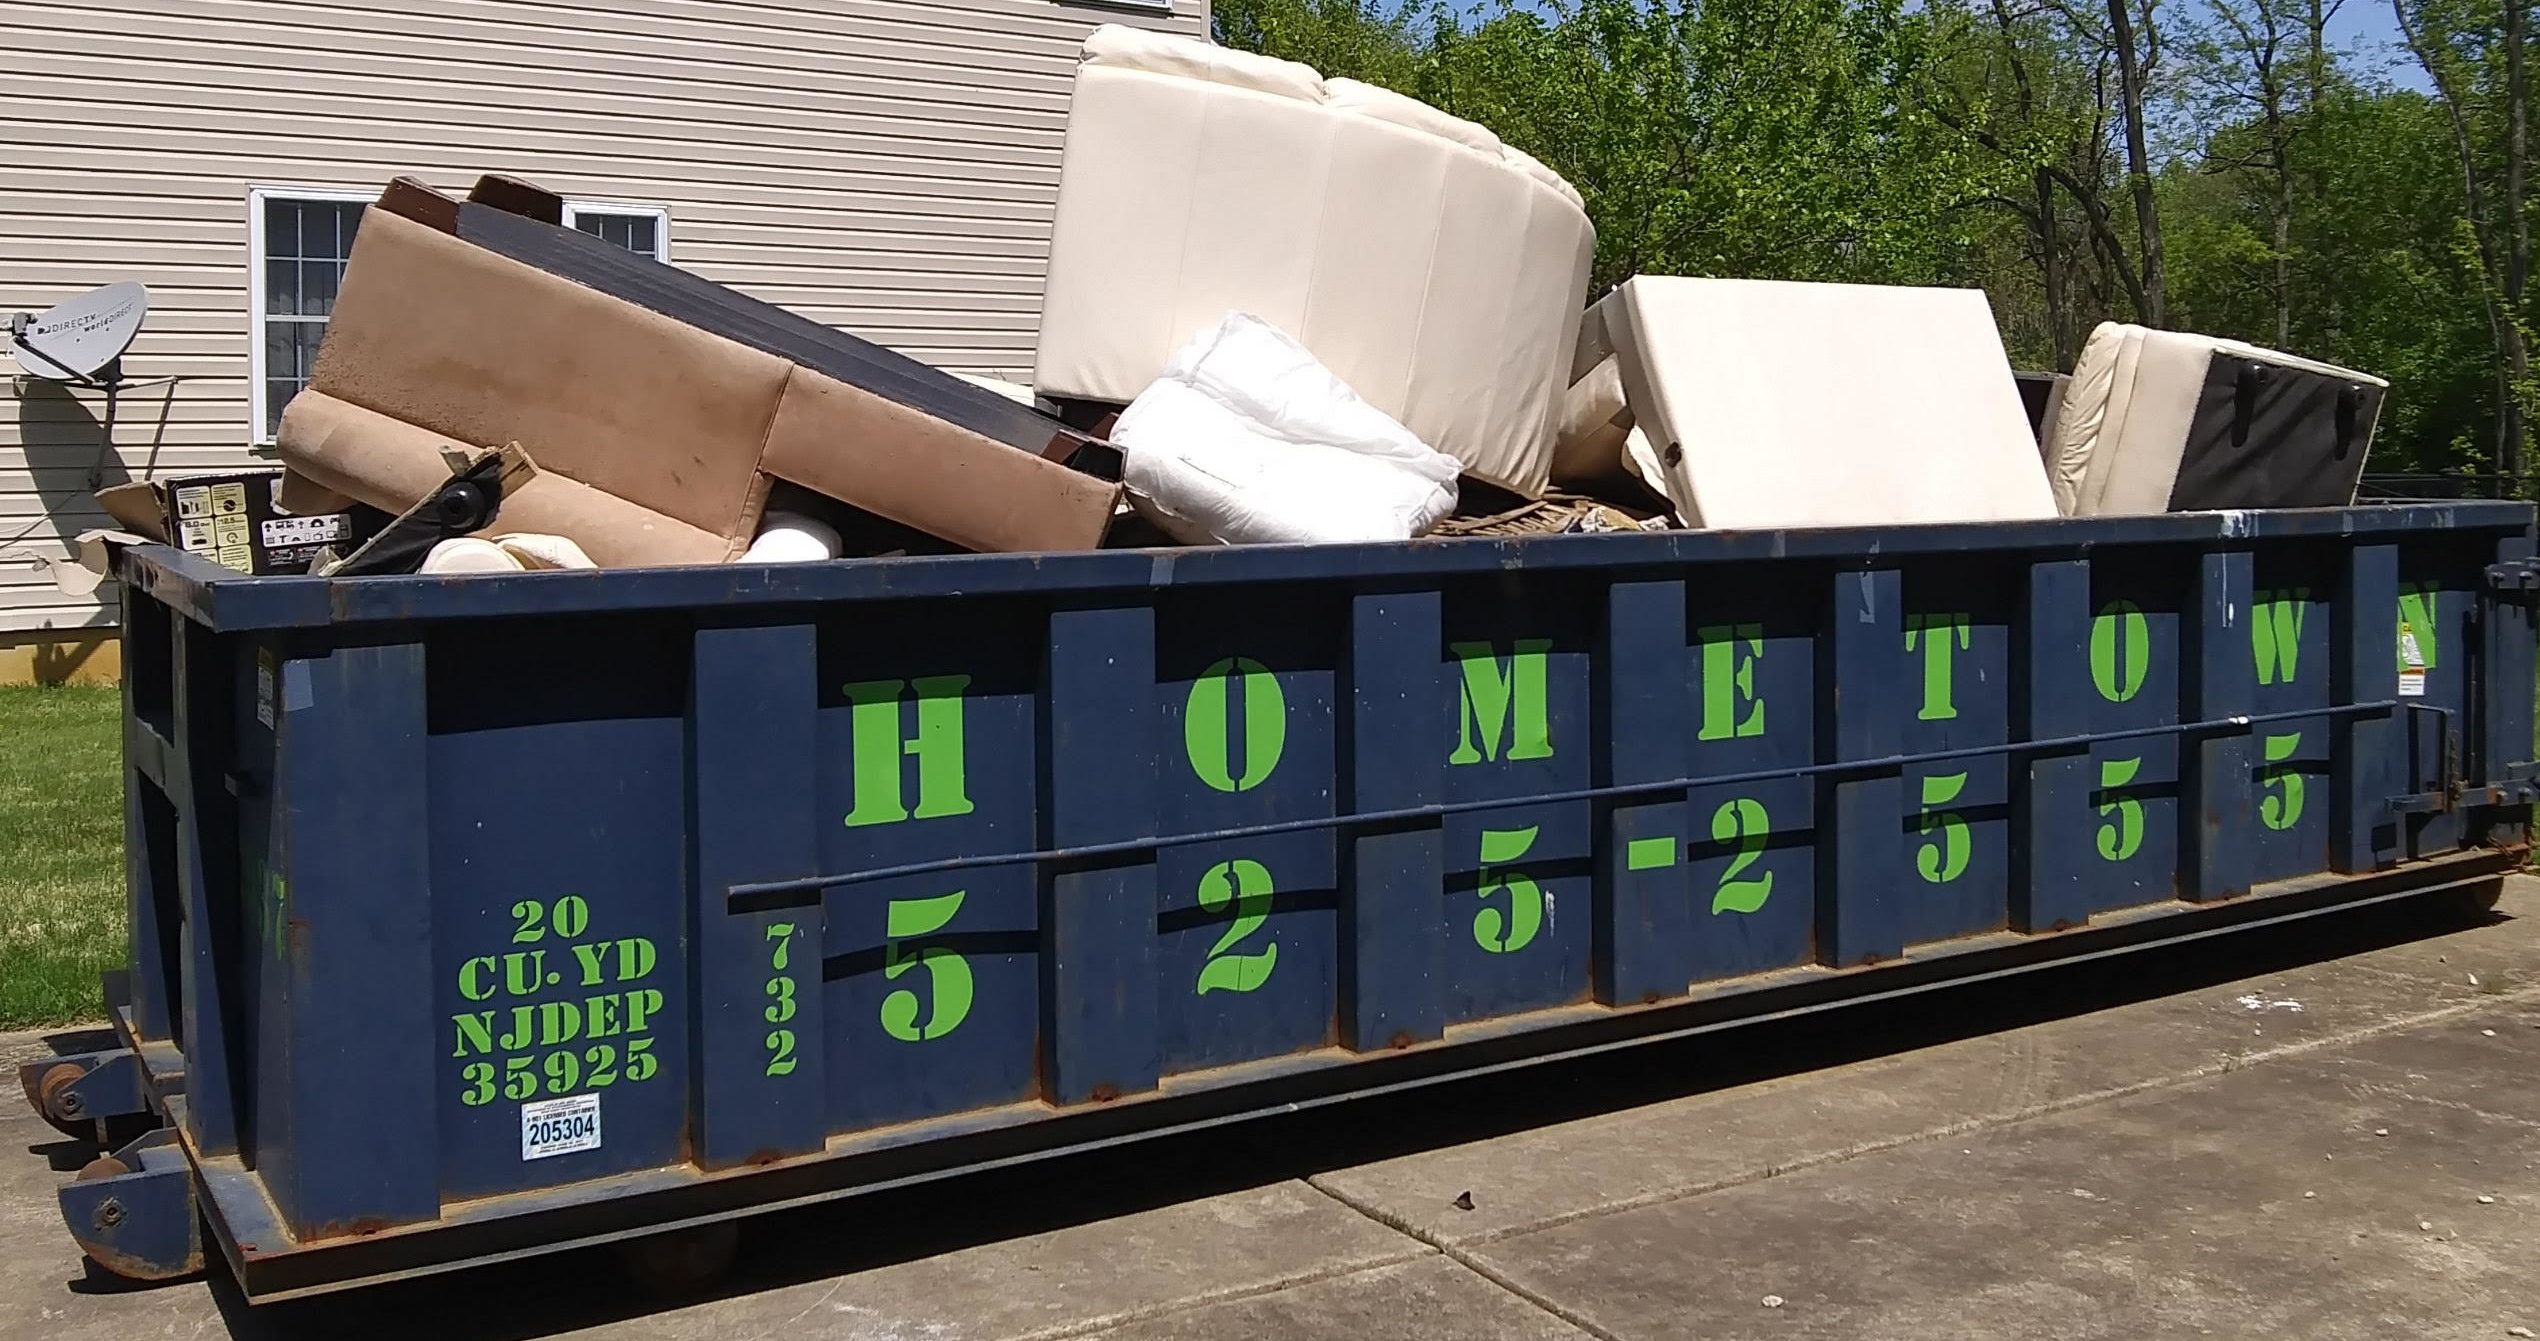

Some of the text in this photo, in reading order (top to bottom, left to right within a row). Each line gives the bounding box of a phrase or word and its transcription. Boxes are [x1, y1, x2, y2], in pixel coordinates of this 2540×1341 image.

[52, 313, 97, 333] DIRECTV
[842, 582, 2438, 827] HOMETOWN
[511, 895, 589, 943] 20
[451, 988, 664, 1058] NJDEP
[461, 1037, 659, 1107] 35925
[529, 1113, 595, 1146] 205304
